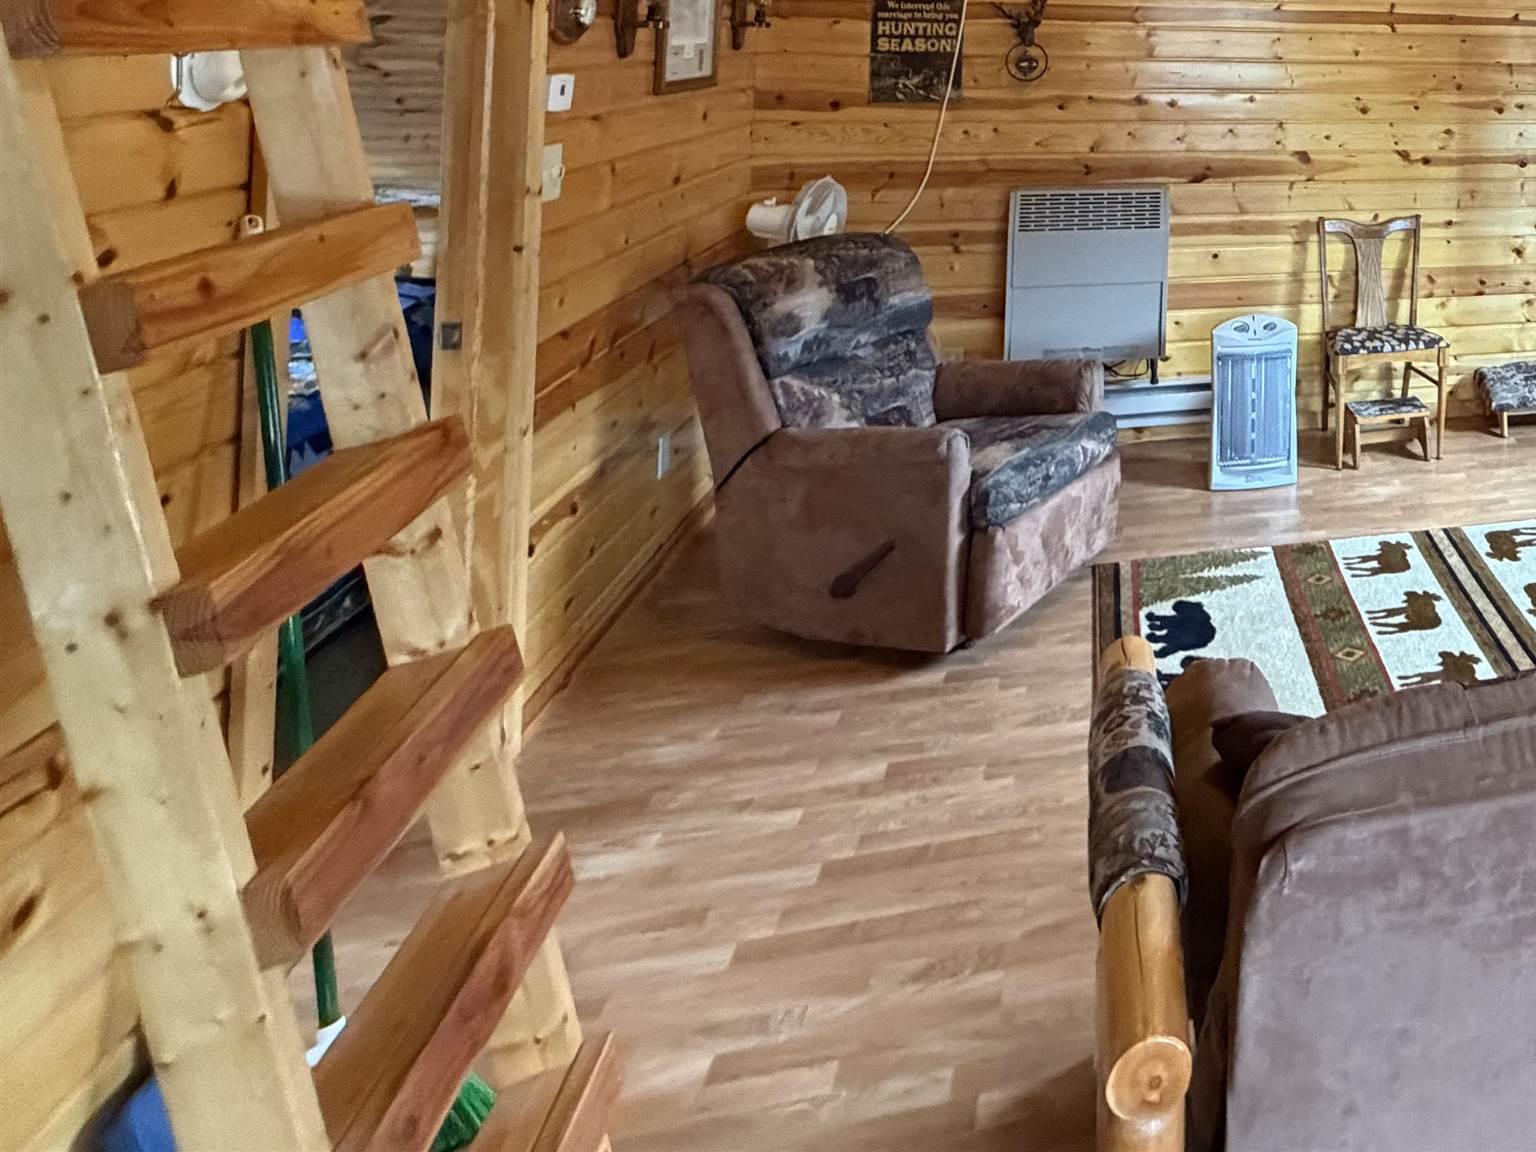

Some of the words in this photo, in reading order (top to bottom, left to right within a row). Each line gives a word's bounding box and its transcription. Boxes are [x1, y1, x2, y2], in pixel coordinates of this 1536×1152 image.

[887, 0, 899, 9] We
[936, 2, 951, 11] this
[914, 11, 922, 19] to
[923, 11, 944, 20] bring
[945, 12, 959, 20] you
[877, 22, 957, 36] HUNTING
[877, 37, 957, 52] SEASON!
